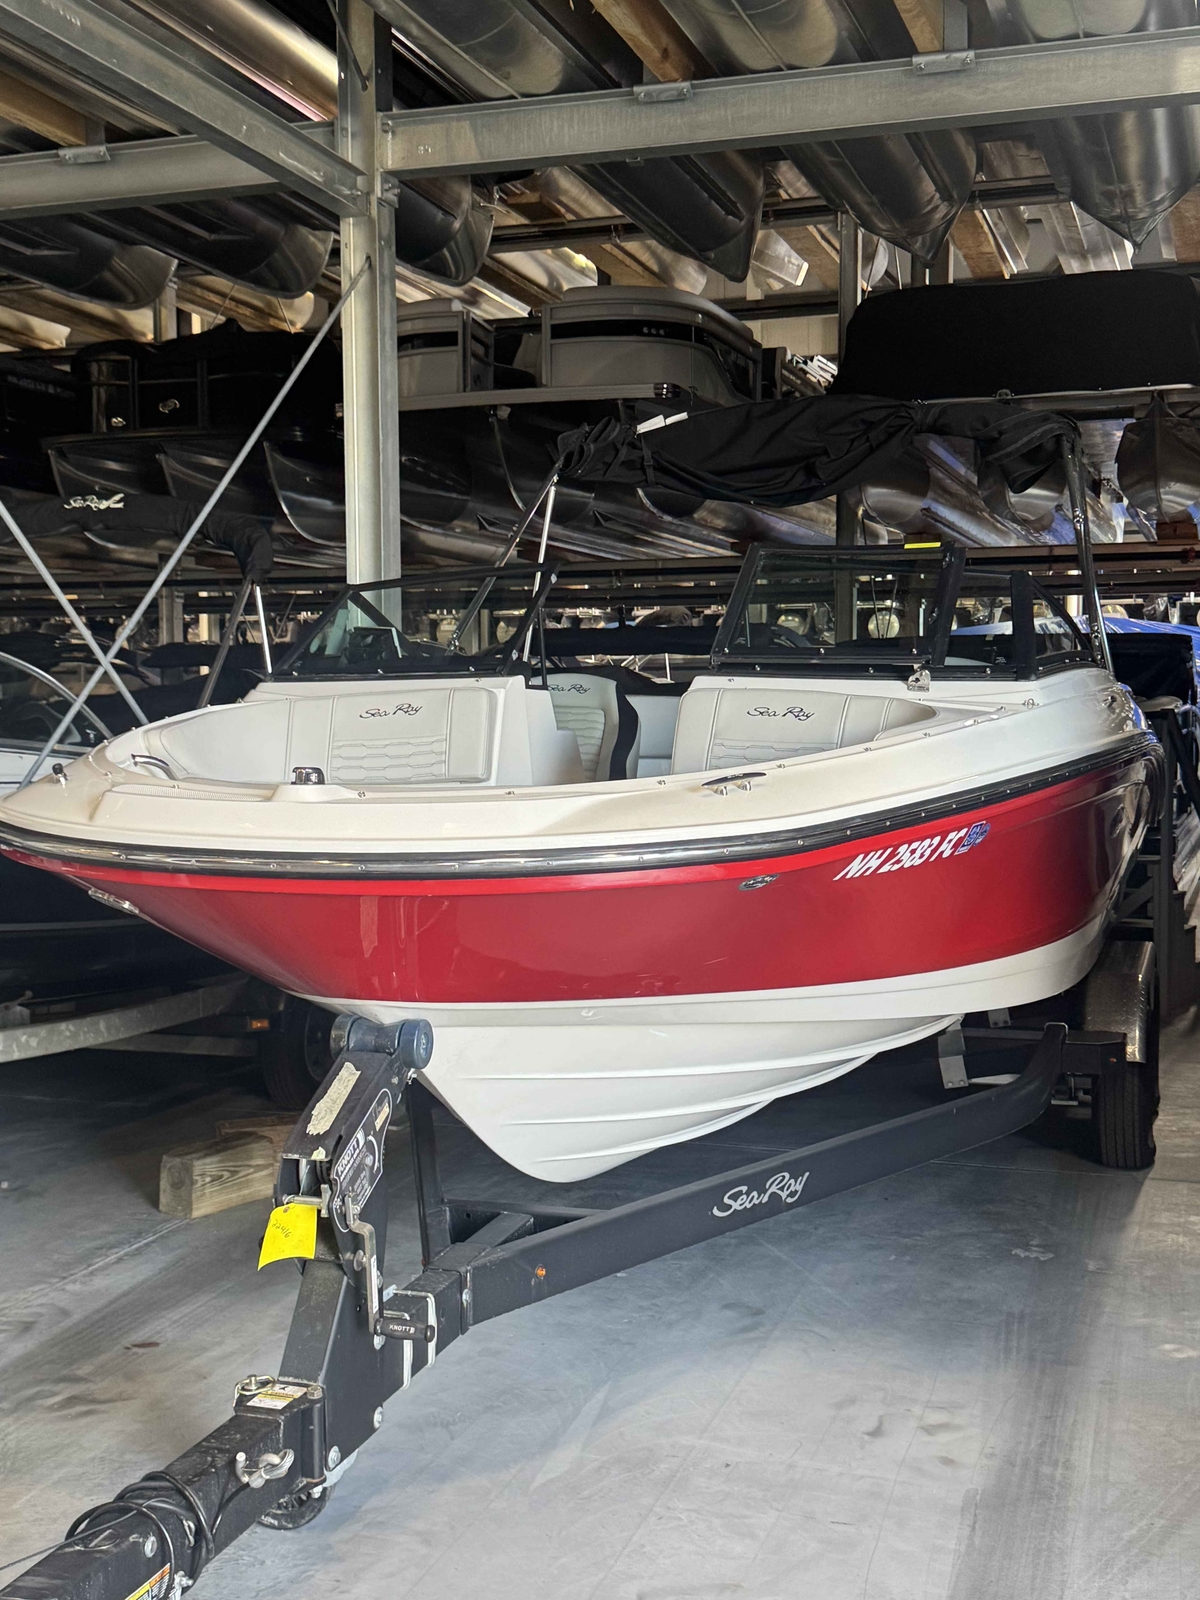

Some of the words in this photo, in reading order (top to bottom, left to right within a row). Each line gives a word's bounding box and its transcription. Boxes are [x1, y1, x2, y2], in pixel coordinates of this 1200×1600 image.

[567, 683, 591, 694] Ray
[359, 708, 390, 719] Sea
[392, 703, 423, 716] Ray
[746, 706, 780, 717] Sea
[781, 706, 815, 721] Ray
[832, 848, 893, 880] NH
[876, 836, 941, 873] 2583
[929, 828, 968, 862] FC
[337, 1138, 358, 1175] KNOTT
[712, 1185, 763, 1217] Sea
[761, 1171, 810, 1203] Ray
[389, 1324, 410, 1332] KNOTT
